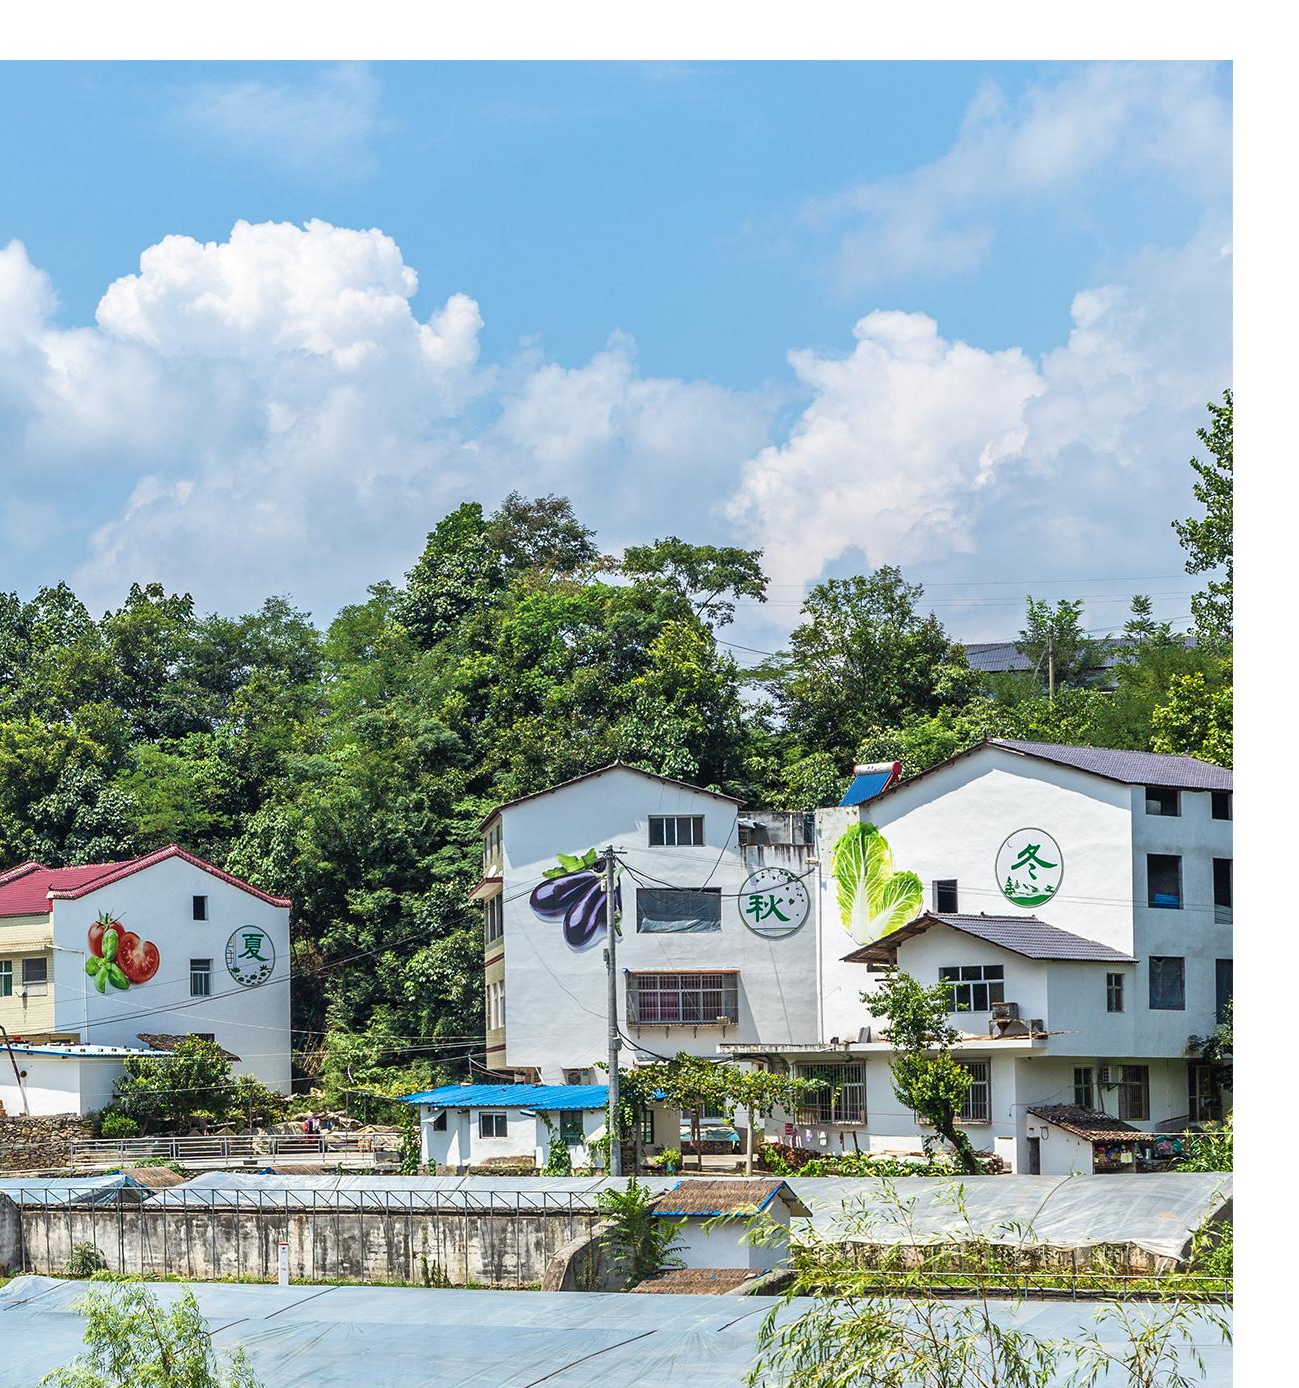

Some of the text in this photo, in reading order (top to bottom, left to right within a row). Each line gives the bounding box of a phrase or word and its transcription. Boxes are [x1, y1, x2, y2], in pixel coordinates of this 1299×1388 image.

[1011, 843, 1058, 880] 冬
[746, 894, 791, 922] 秋
[238, 933, 270, 962] 夏
